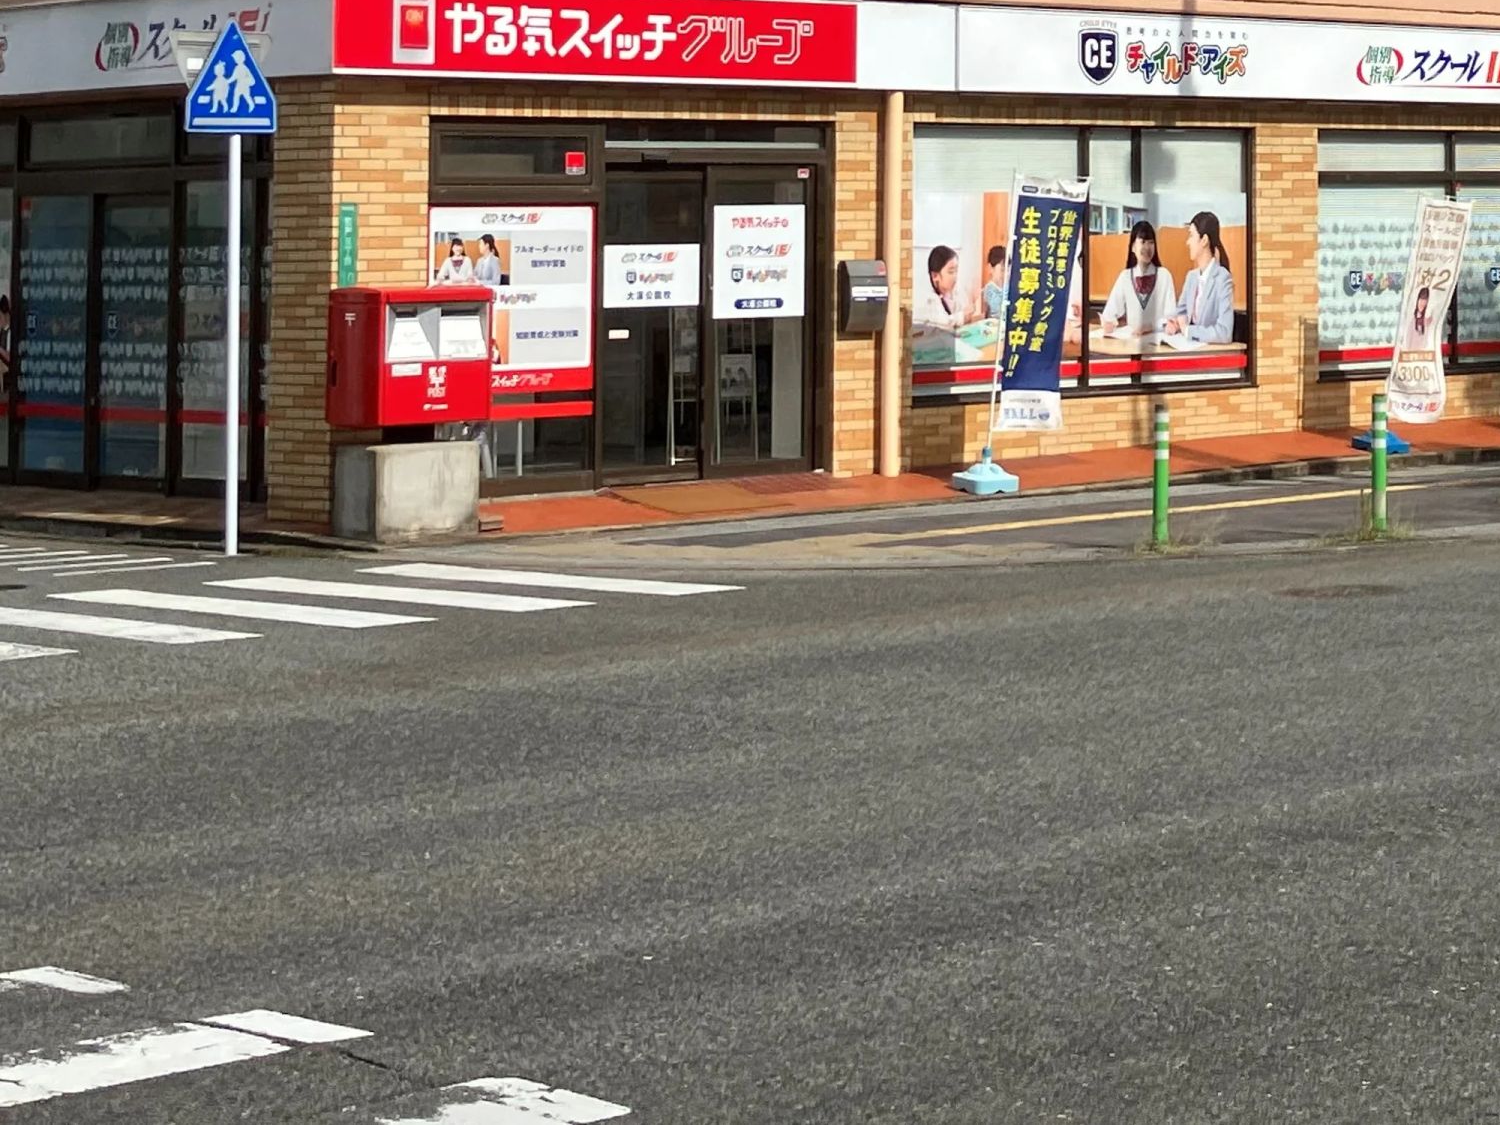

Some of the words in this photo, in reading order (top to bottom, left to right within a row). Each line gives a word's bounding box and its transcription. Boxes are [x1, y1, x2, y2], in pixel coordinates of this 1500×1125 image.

[444, 2, 814, 66] やる気スイッチグループ
[1084, 37, 1114, 69] CE
[1366, 45, 1393, 64] 個別
[1369, 65, 1396, 85] 指導
